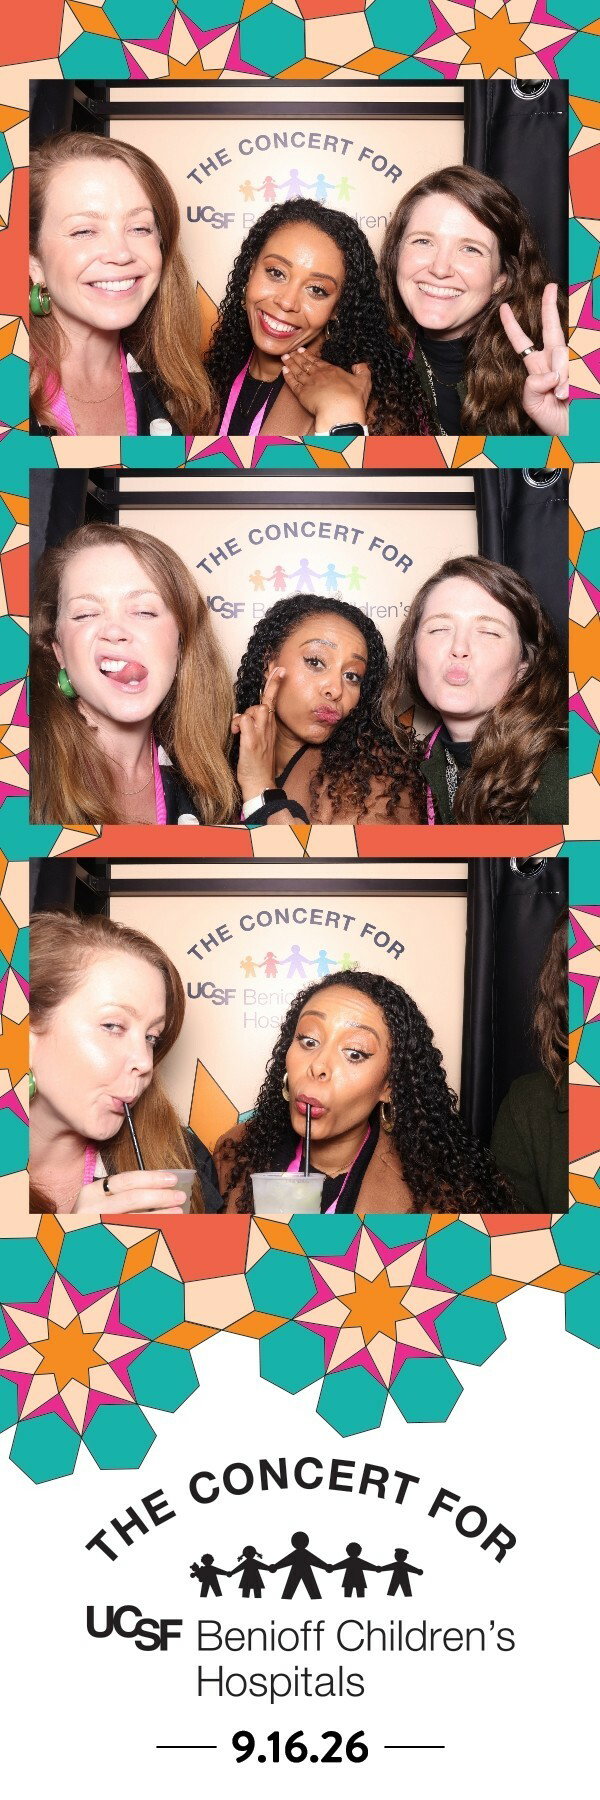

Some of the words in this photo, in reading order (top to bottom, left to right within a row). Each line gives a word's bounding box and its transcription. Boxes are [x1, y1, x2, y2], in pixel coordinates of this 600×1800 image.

[186, 147, 232, 185] THE
[238, 131, 353, 156] CONCERT
[357, 146, 403, 184] FOR
[186, 205, 235, 229] UCSF
[196, 537, 242, 574] THE
[248, 521, 364, 545] CONCERT
[368, 536, 414, 574] FOR
[352, 602, 411, 618] dren’s
[186, 923, 233, 961] THE
[239, 907, 356, 932] CONCERT
[359, 922, 405, 960] FOR
[187, 981, 236, 1006] UCSF
[243, 988, 295, 1006] Benio
